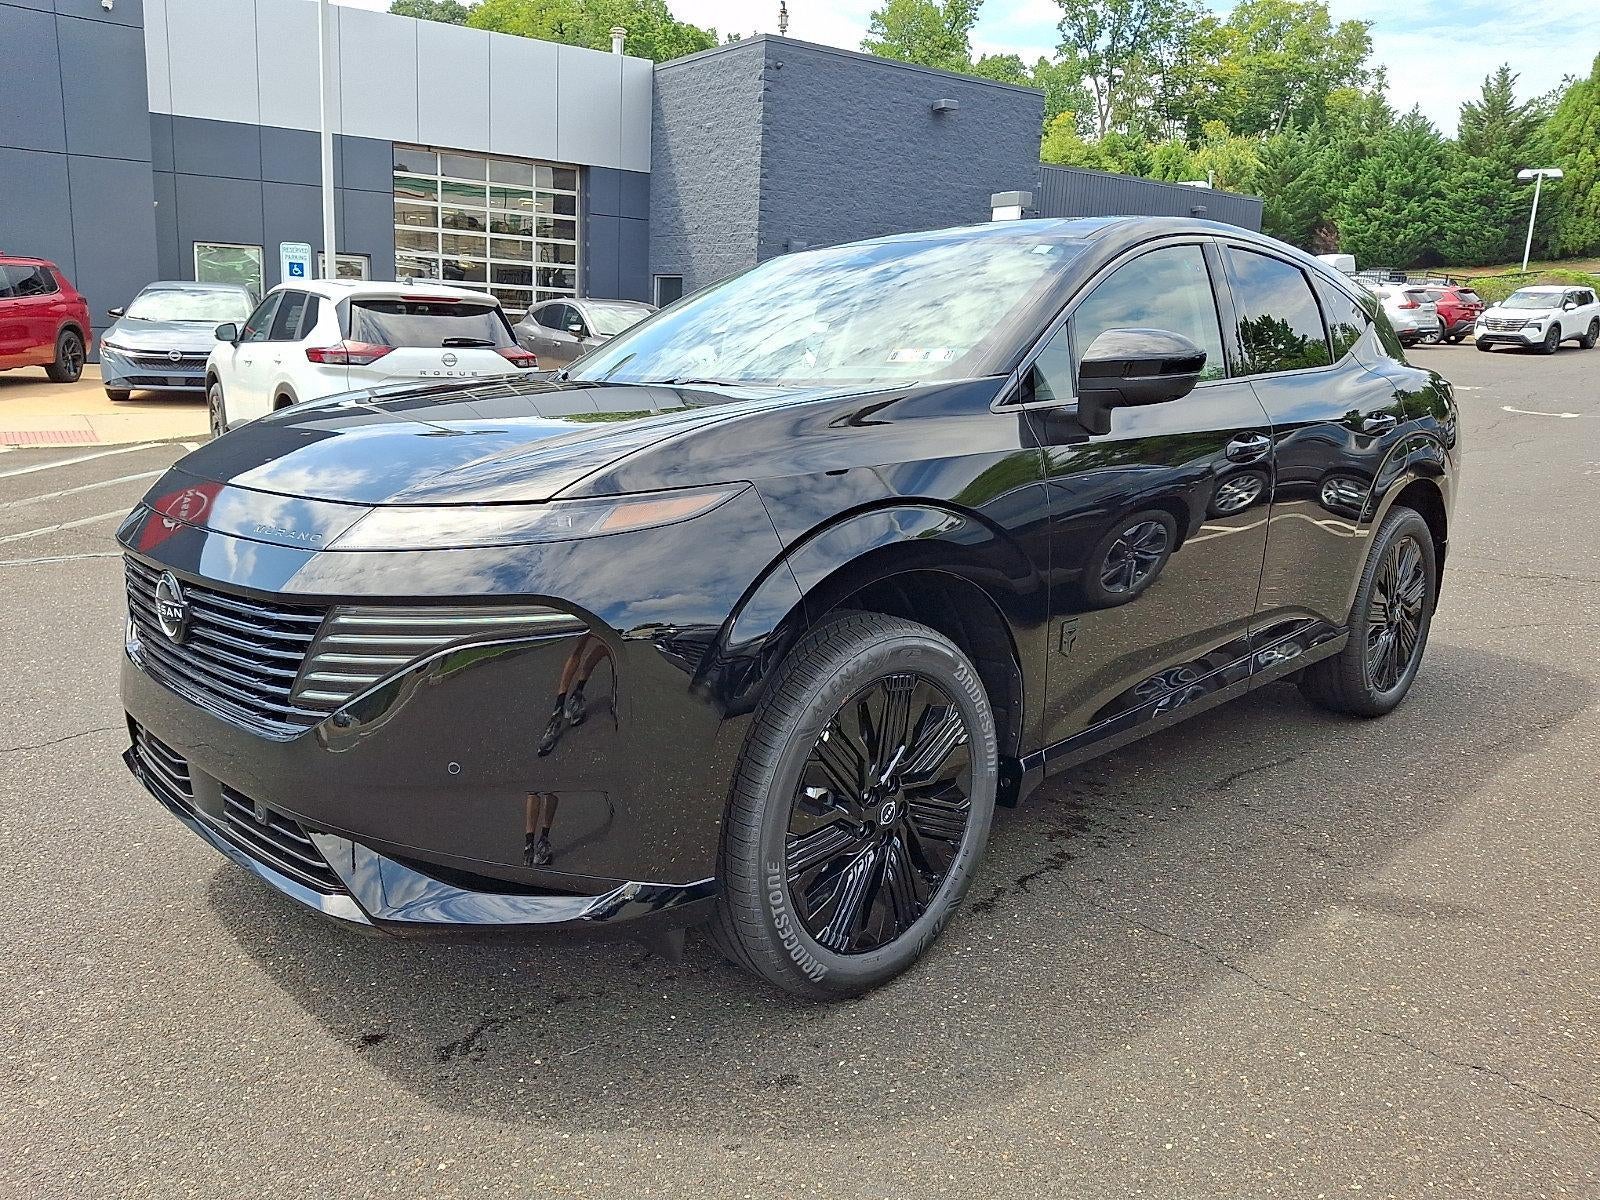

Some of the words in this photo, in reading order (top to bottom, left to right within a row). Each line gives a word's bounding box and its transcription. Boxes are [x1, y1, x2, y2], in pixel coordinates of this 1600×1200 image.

[282, 246, 309, 254] RESERVED
[253, 524, 323, 542] MURANO
[953, 663, 997, 777] BRIDGESTONE
[766, 861, 829, 984] BRIDGESTONE
